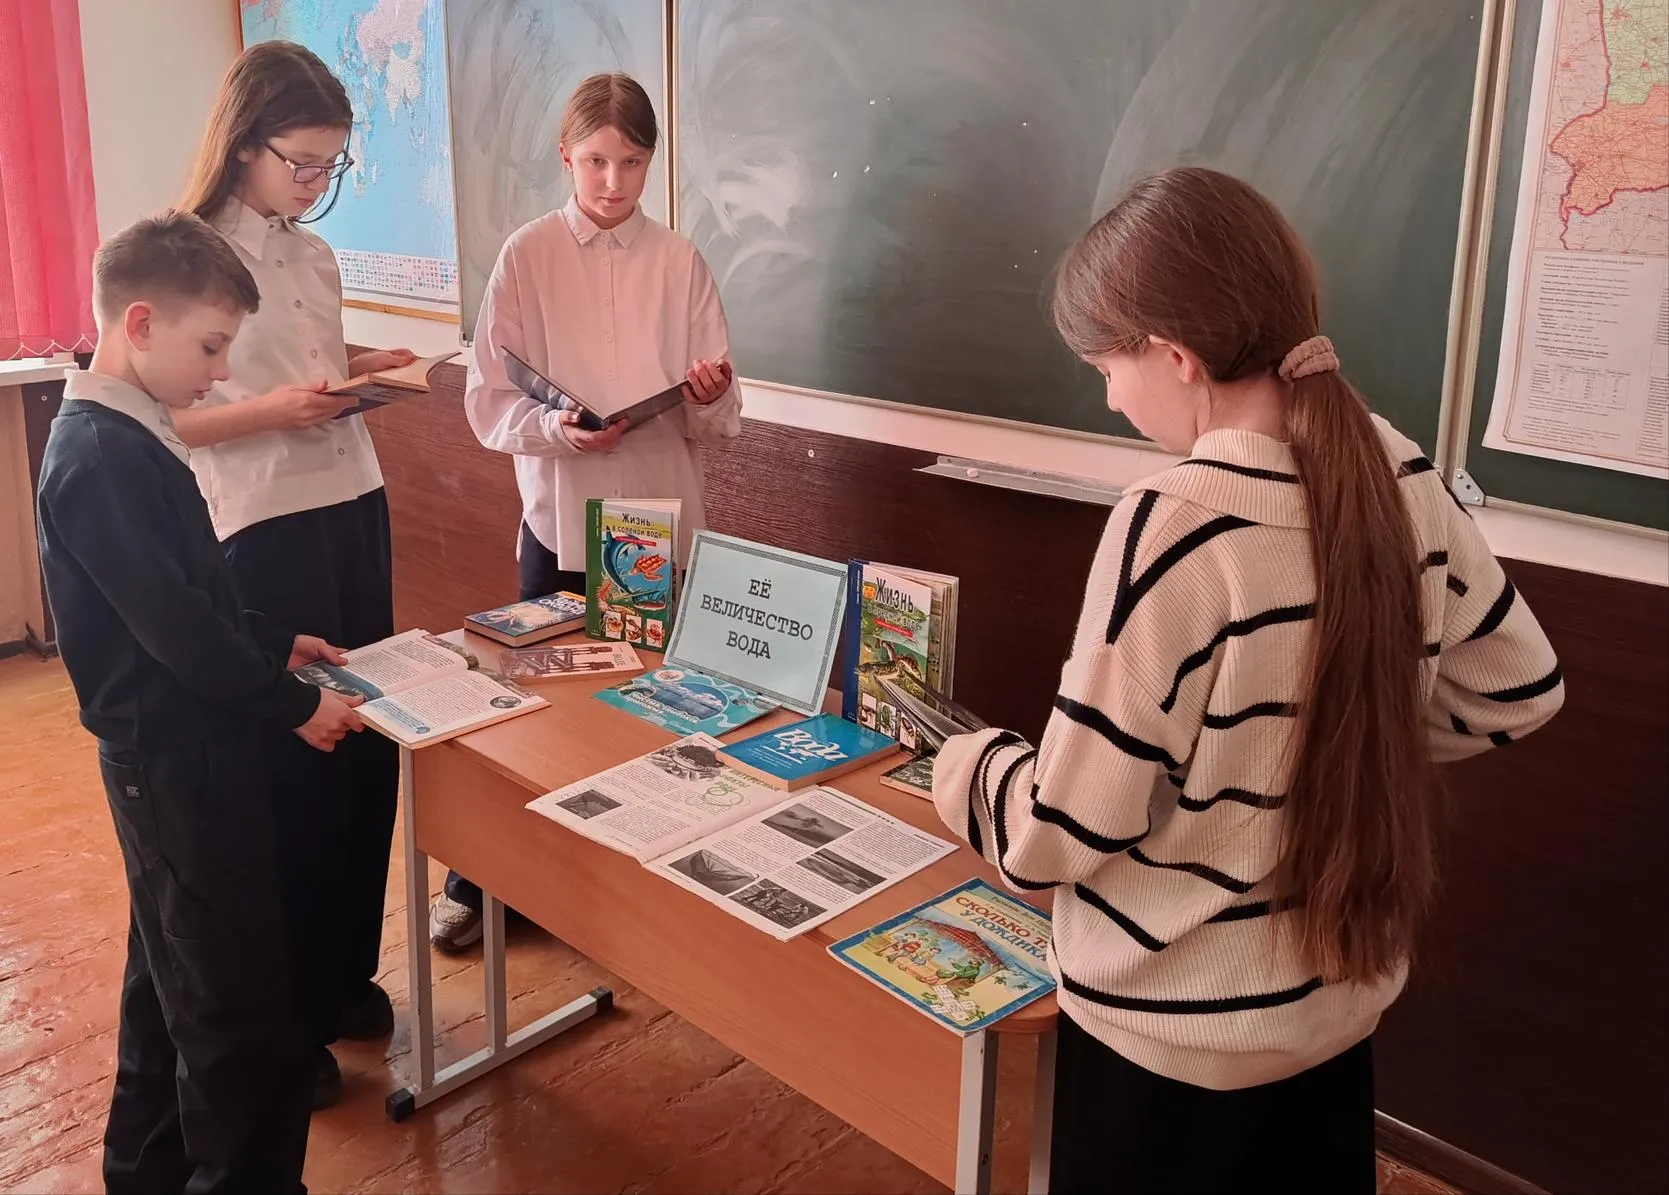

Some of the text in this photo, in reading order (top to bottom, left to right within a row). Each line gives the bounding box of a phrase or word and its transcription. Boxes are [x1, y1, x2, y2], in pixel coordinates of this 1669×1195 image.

[748, 578, 772, 599] ЕЁ
[700, 594, 814, 641] ВЕЛИЧЕСТВО
[726, 630, 771, 659] ВОДА
[774, 729, 849, 761] Вода
[955, 896, 1031, 938] СКОЛЬКО
